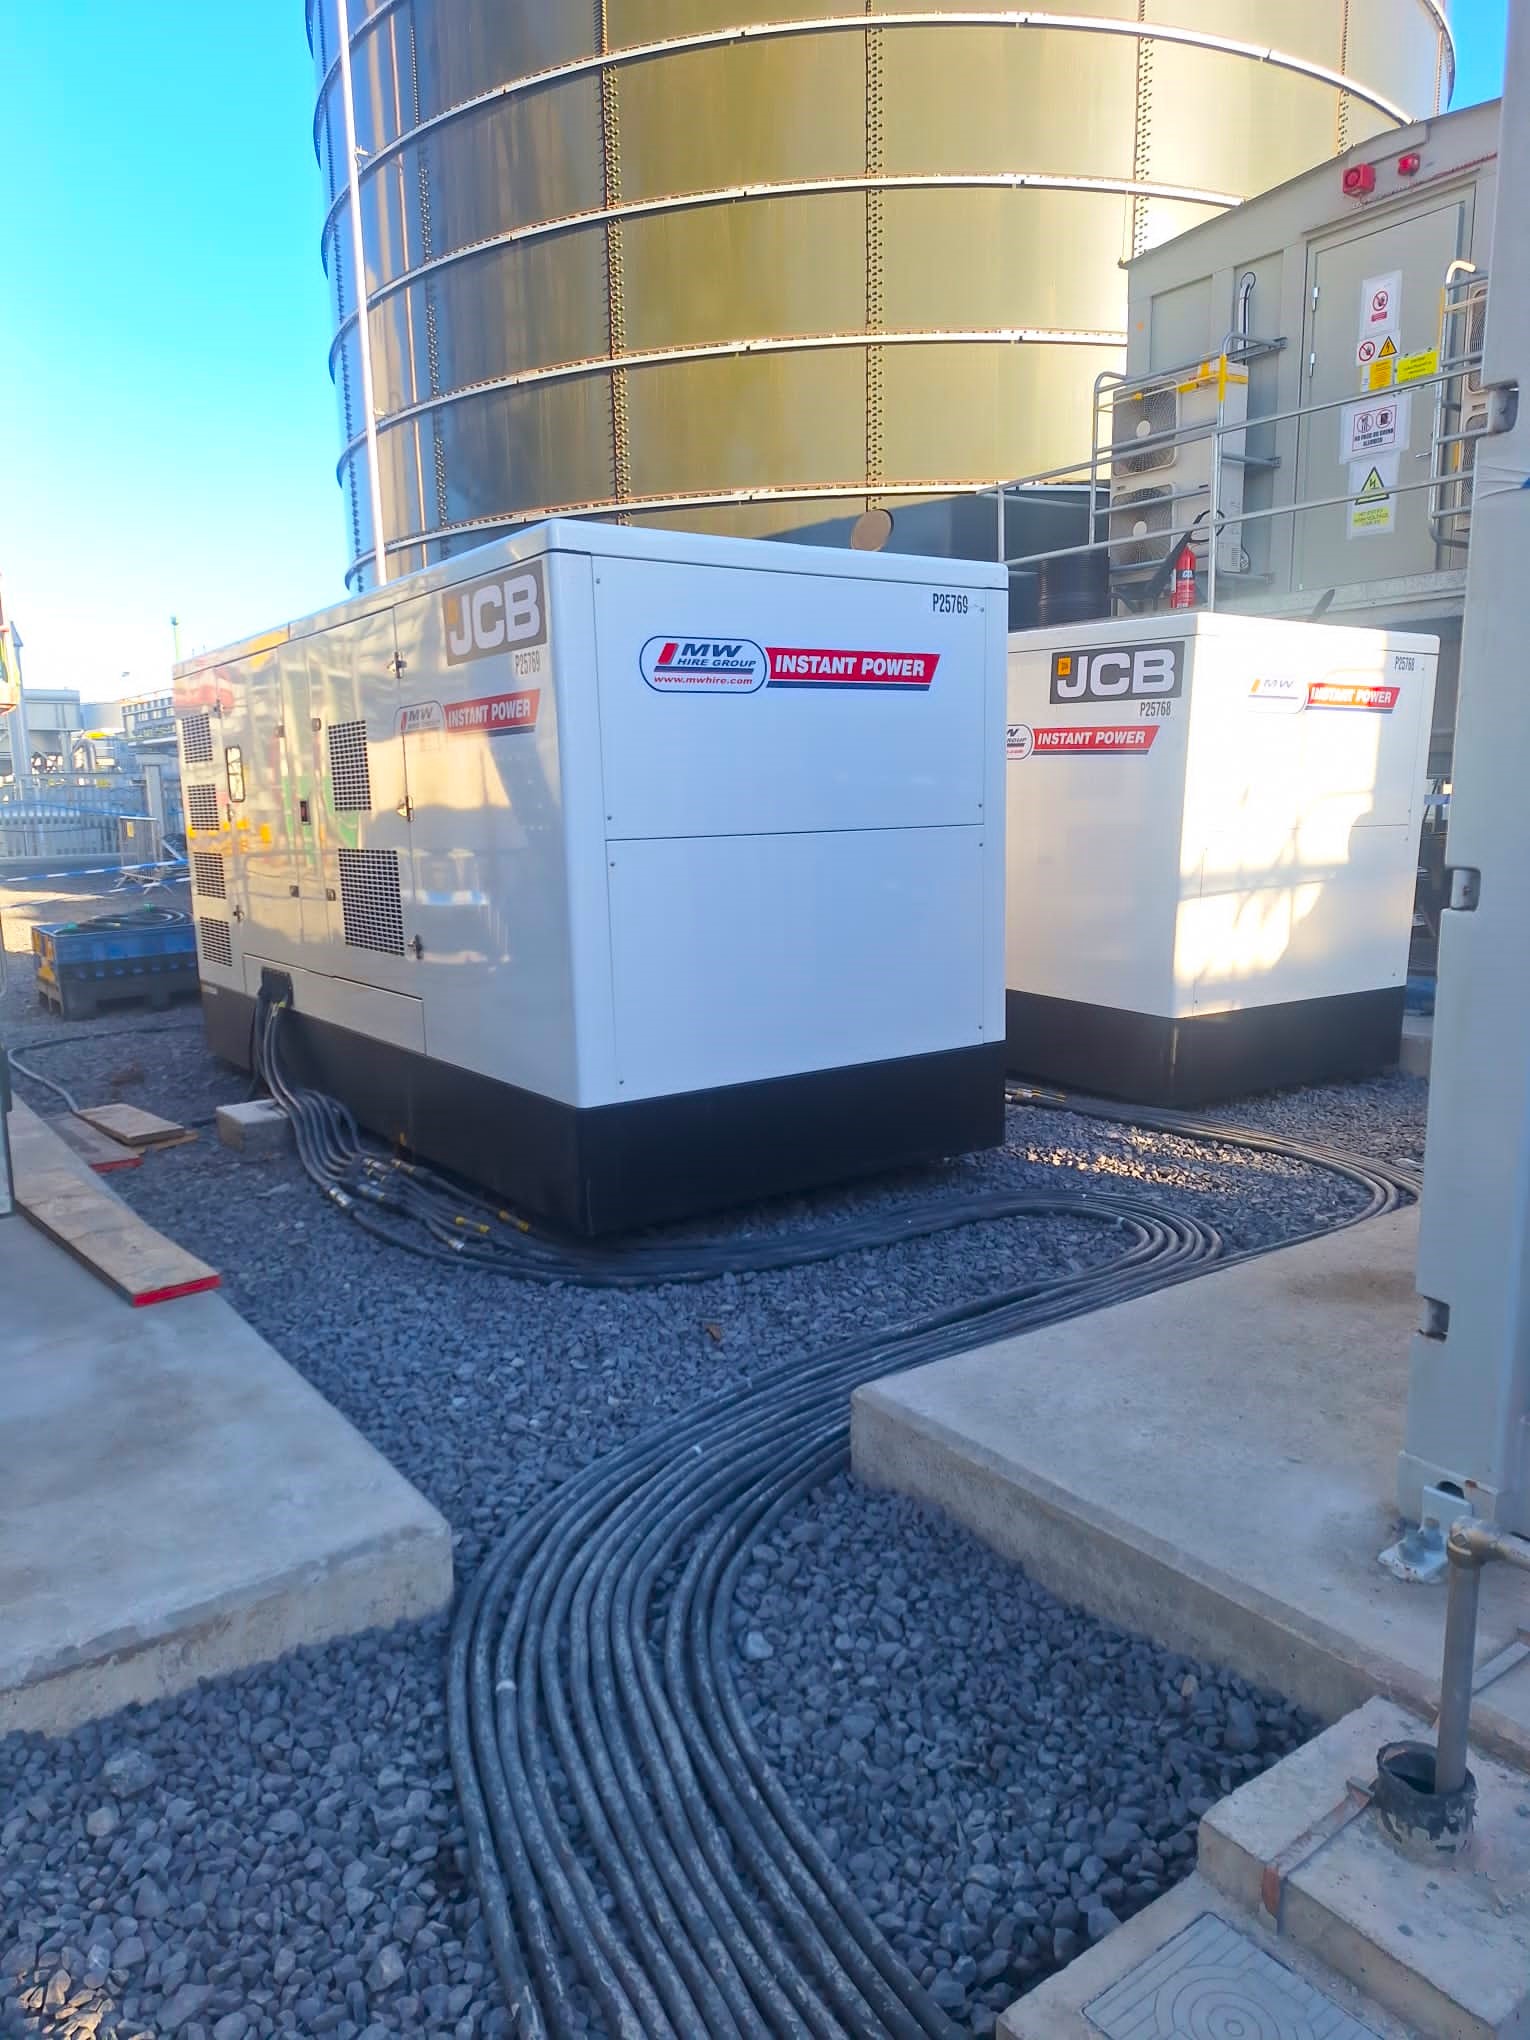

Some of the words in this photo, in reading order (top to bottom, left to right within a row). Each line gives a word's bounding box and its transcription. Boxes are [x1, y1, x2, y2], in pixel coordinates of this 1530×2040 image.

[932, 593, 969, 614] P25769
[449, 574, 541, 656] JCB
[681, 643, 743, 658] MW
[677, 658, 709, 666] HIRE
[712, 659, 757, 668] GROUP
[775, 654, 857, 675] INSTANT
[861, 657, 925, 677] POWER
[653, 675, 753, 685] www.mwhire.com
[1056, 648, 1176, 699] JCB
[1356, 688, 1392, 704] POWER
[447, 705, 489, 728] INSTANT
[491, 698, 531, 721] POWER
[1139, 701, 1172, 718] P25768
[1037, 732, 1093, 746] INSTANT
[1095, 730, 1146, 745] POWER
